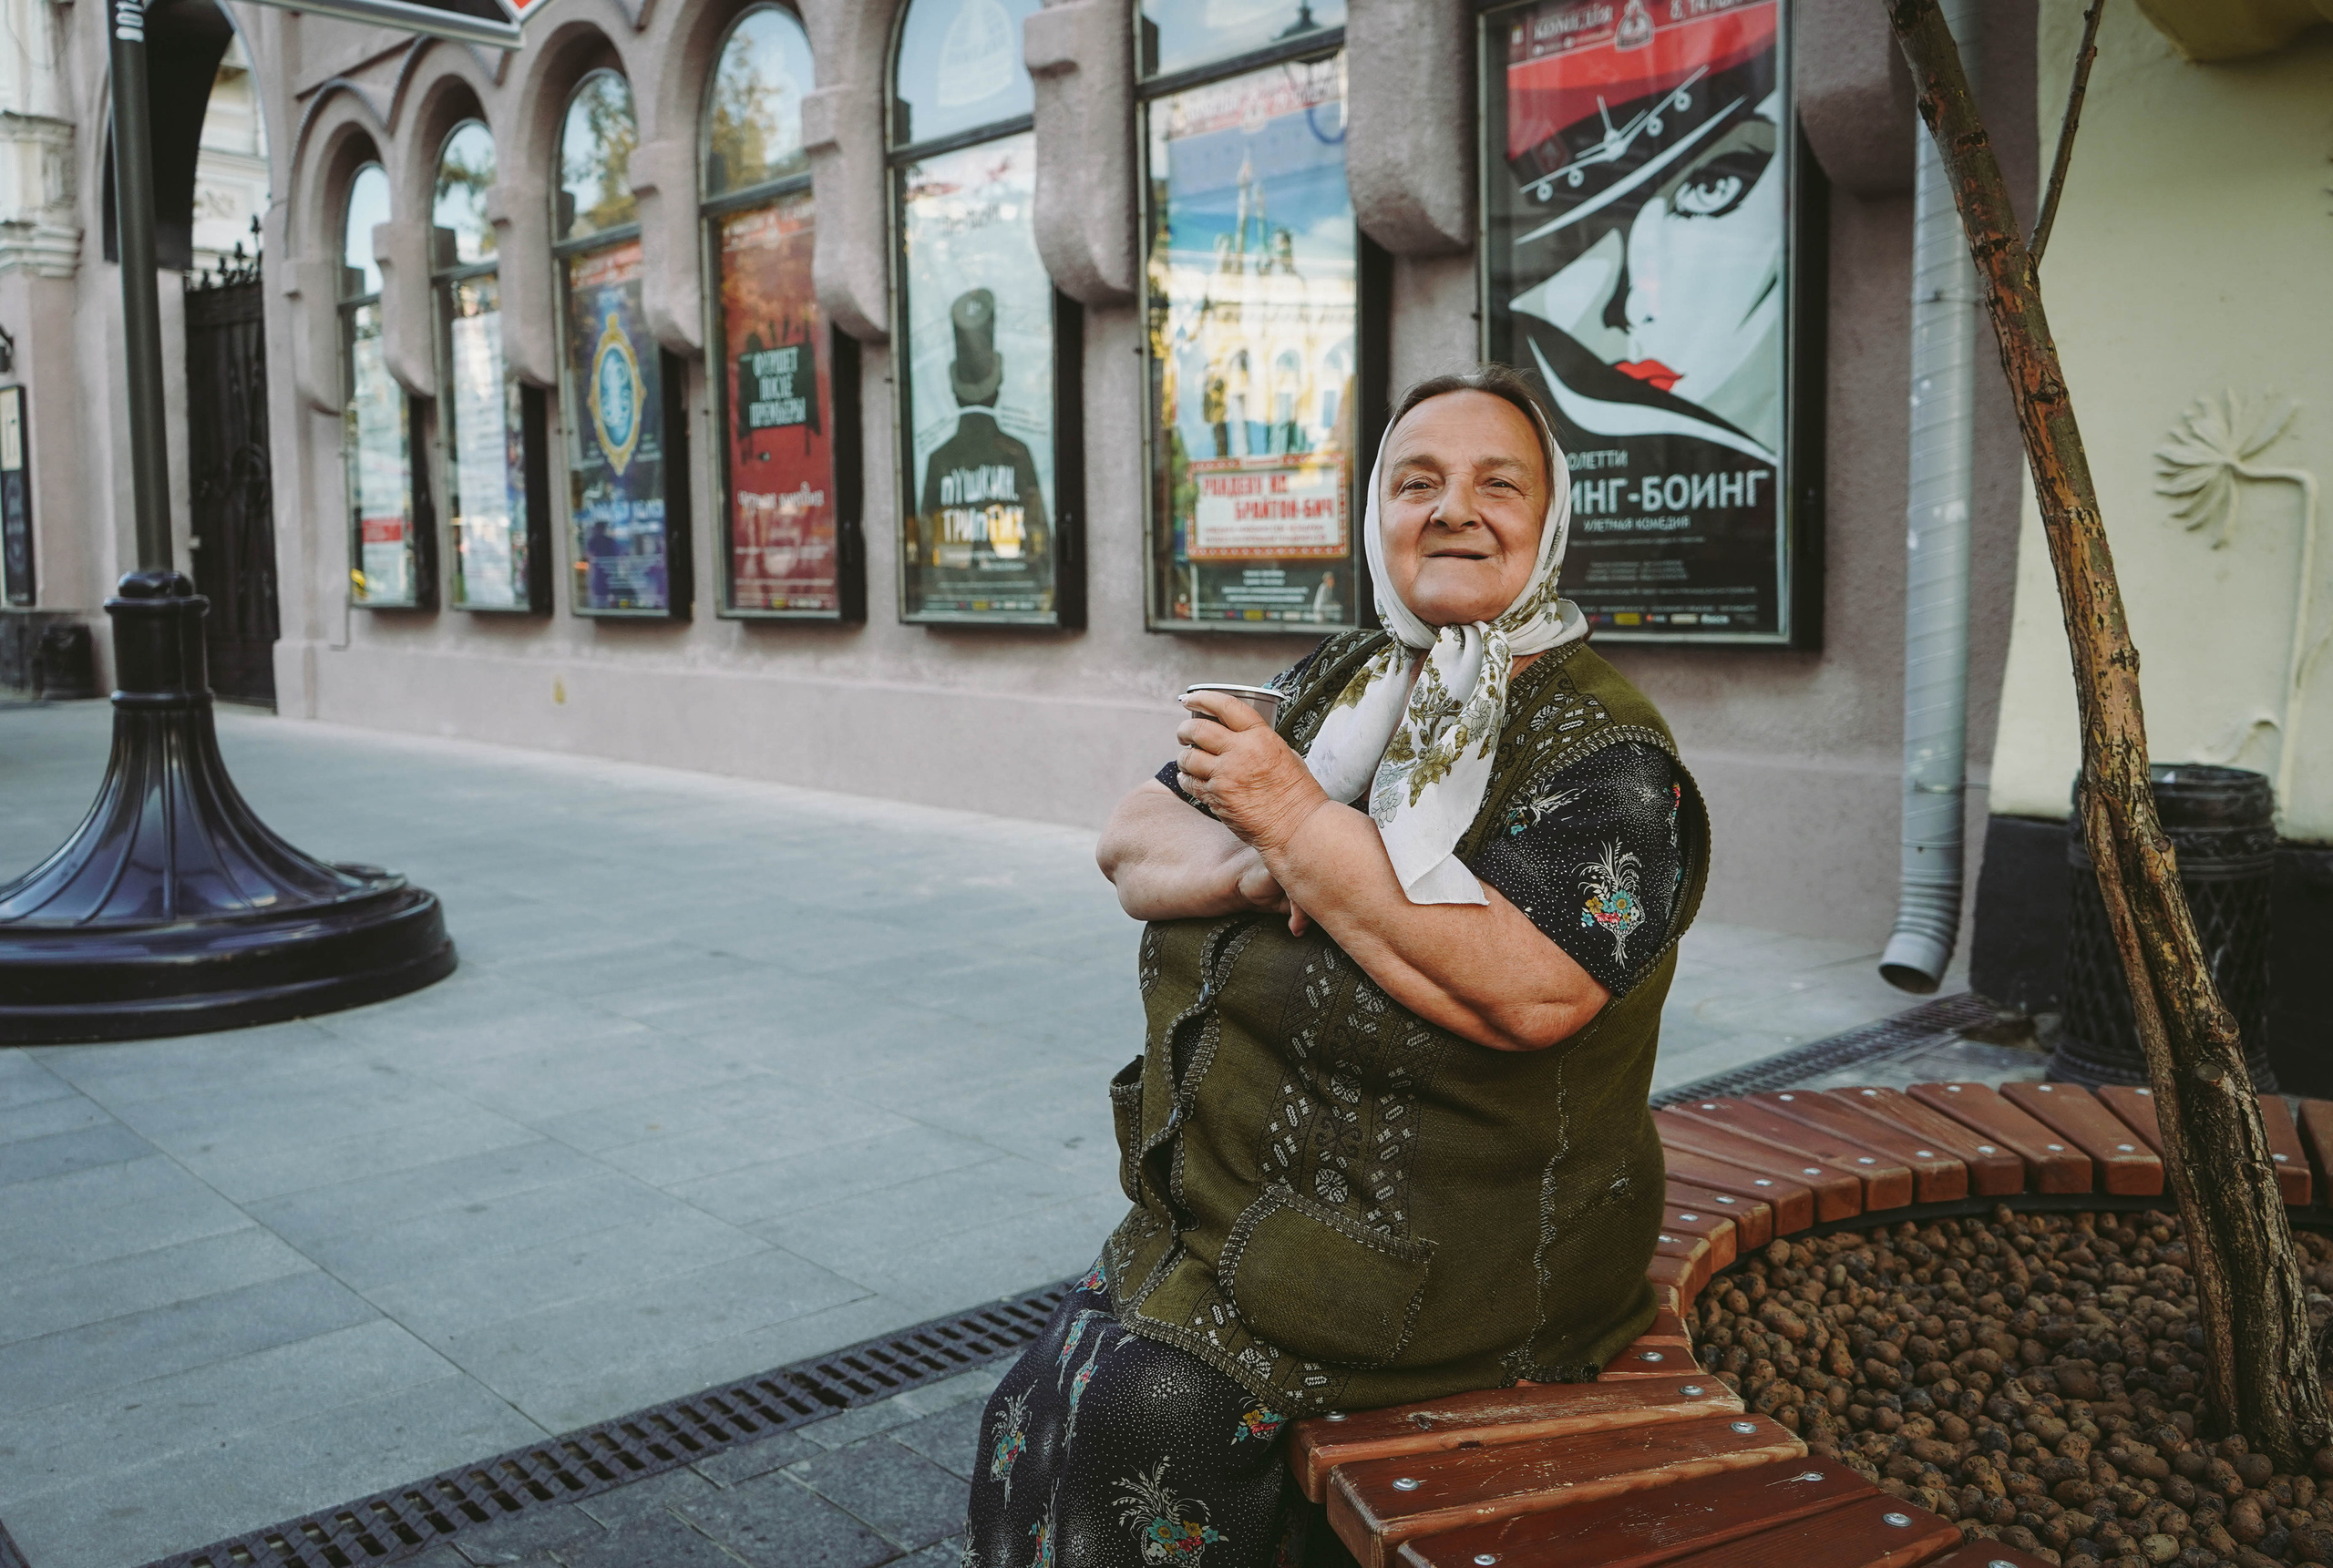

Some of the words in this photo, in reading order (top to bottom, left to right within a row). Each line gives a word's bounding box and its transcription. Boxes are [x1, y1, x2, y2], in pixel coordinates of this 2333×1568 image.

[1567, 449, 1629, 471] ОЛЕТТИ
[1570, 469, 1770, 515] ИНГ-БОИНГ
[1583, 518, 1633, 533] УЛЕТНАЯ
[1635, 515, 1691, 531] КОМЕДИЯ
